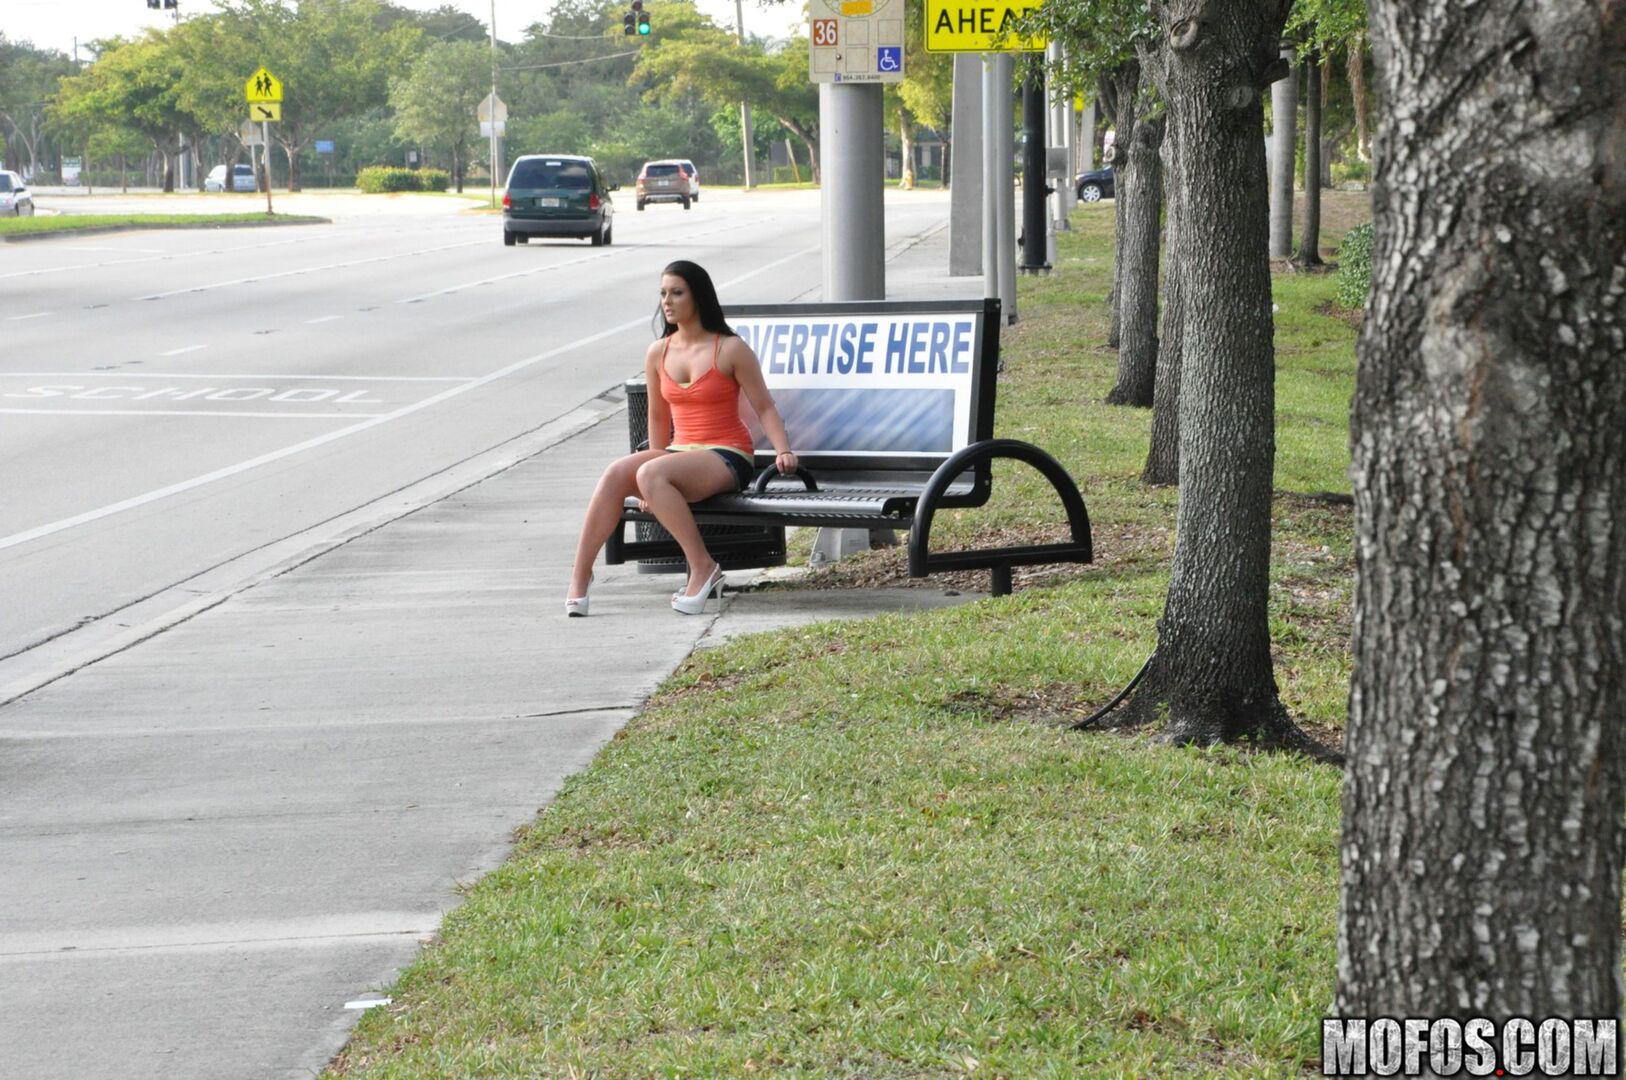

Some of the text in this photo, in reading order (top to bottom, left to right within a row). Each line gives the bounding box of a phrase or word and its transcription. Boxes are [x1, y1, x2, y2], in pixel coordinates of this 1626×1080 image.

[815, 21, 836, 44] 36
[736, 321, 972, 375] VERTISE HERE
[4, 385, 383, 403] SCHOOL
